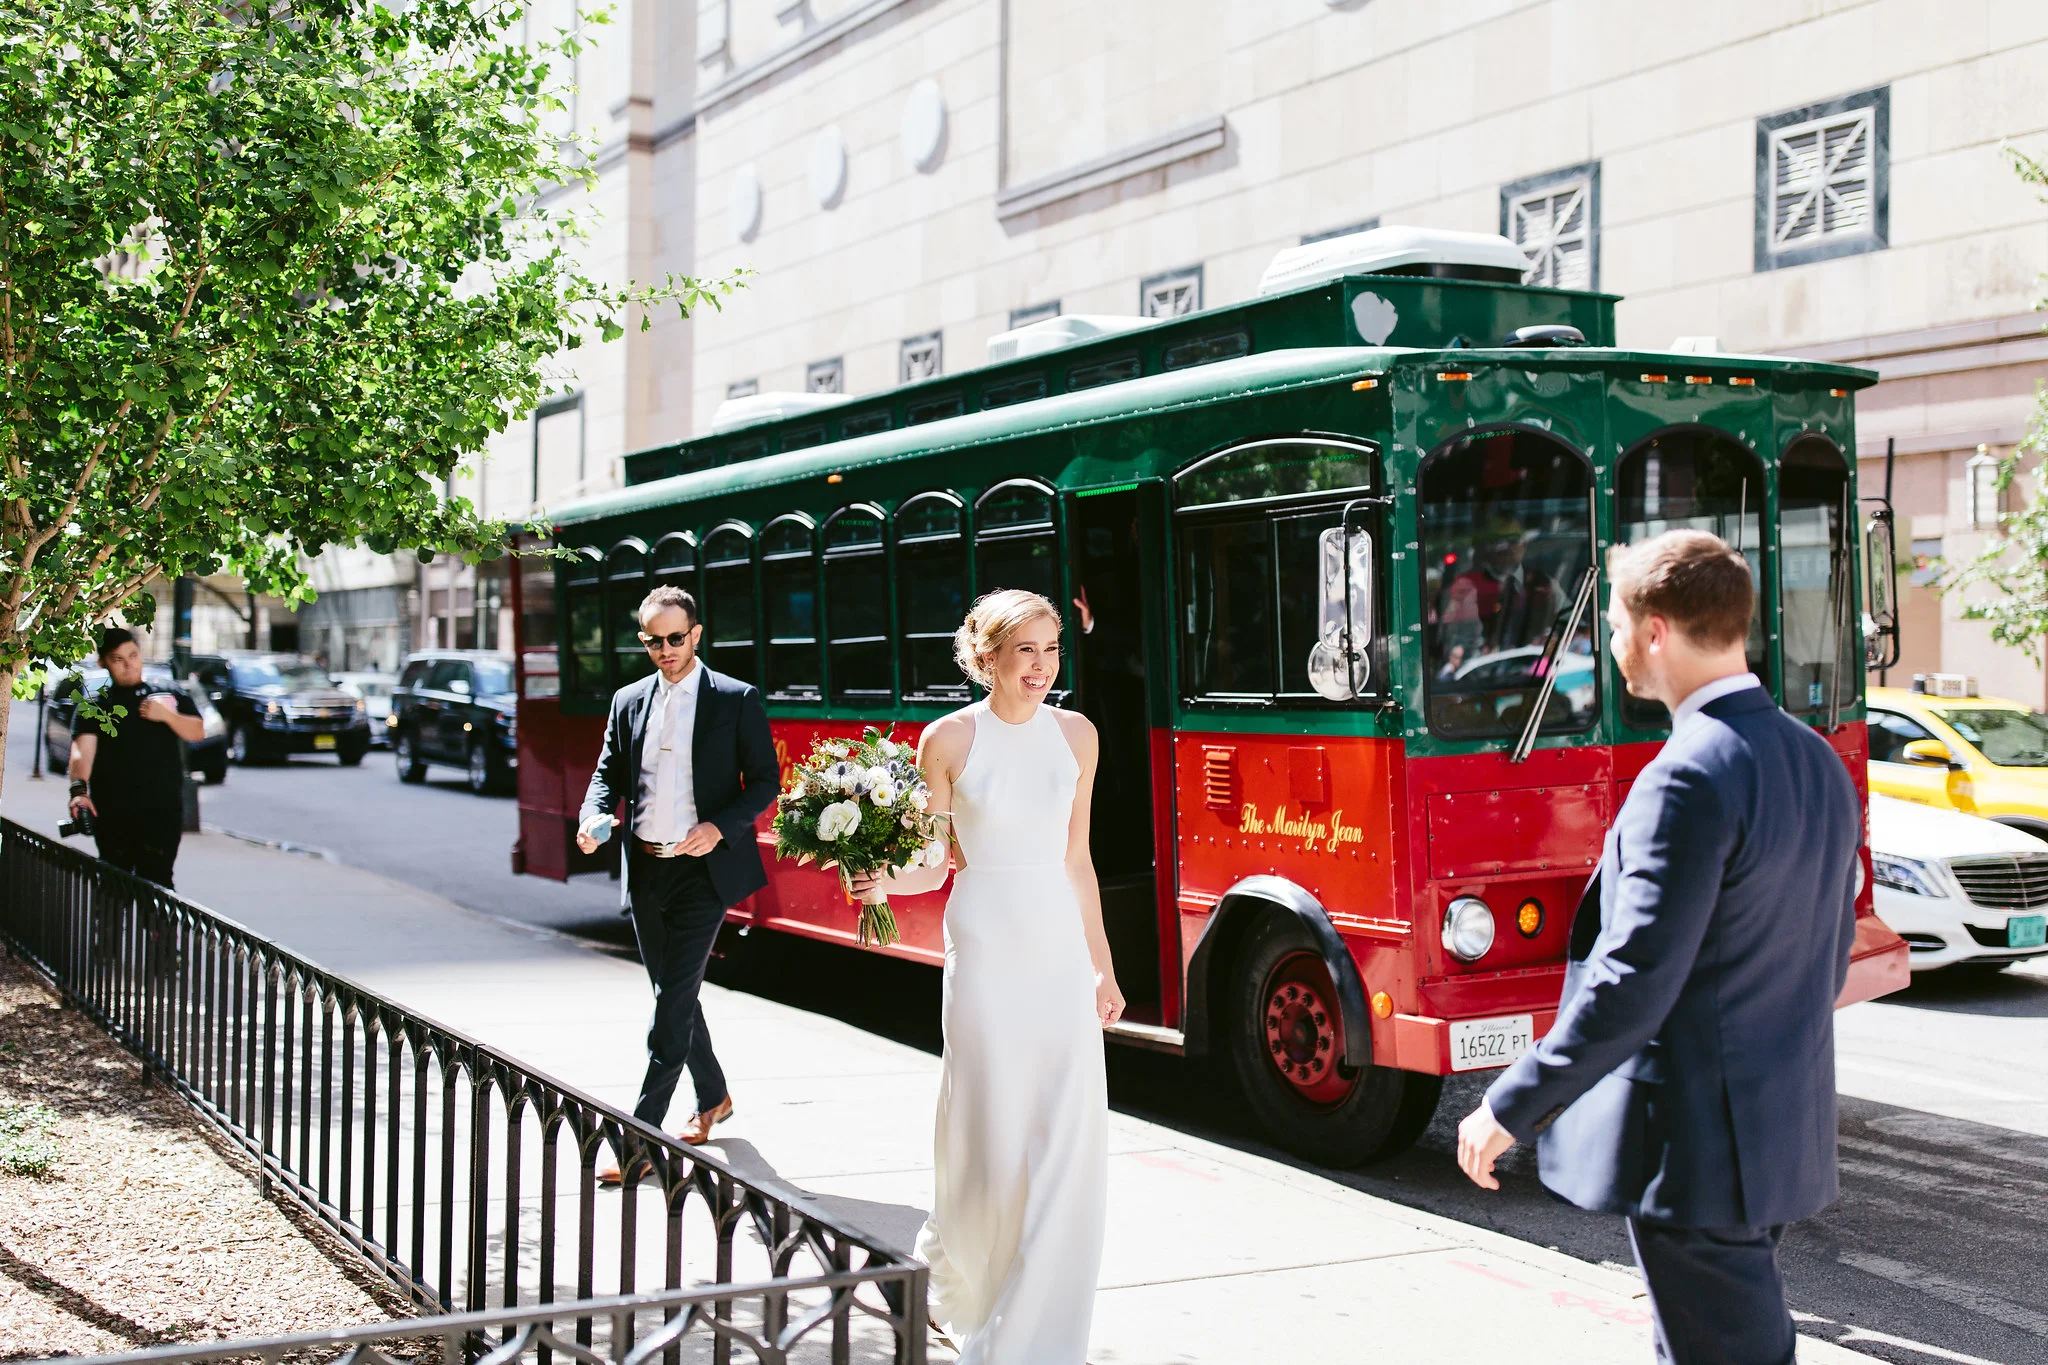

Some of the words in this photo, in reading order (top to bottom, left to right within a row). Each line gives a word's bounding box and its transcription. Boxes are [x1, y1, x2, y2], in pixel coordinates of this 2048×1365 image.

[1240, 803, 1265, 834] The
[1266, 805, 1327, 850] Marilyn
[1327, 810, 1364, 852] Jean
[1460, 1033, 1506, 1059] 16522
[1512, 1034, 1527, 1050] PT
